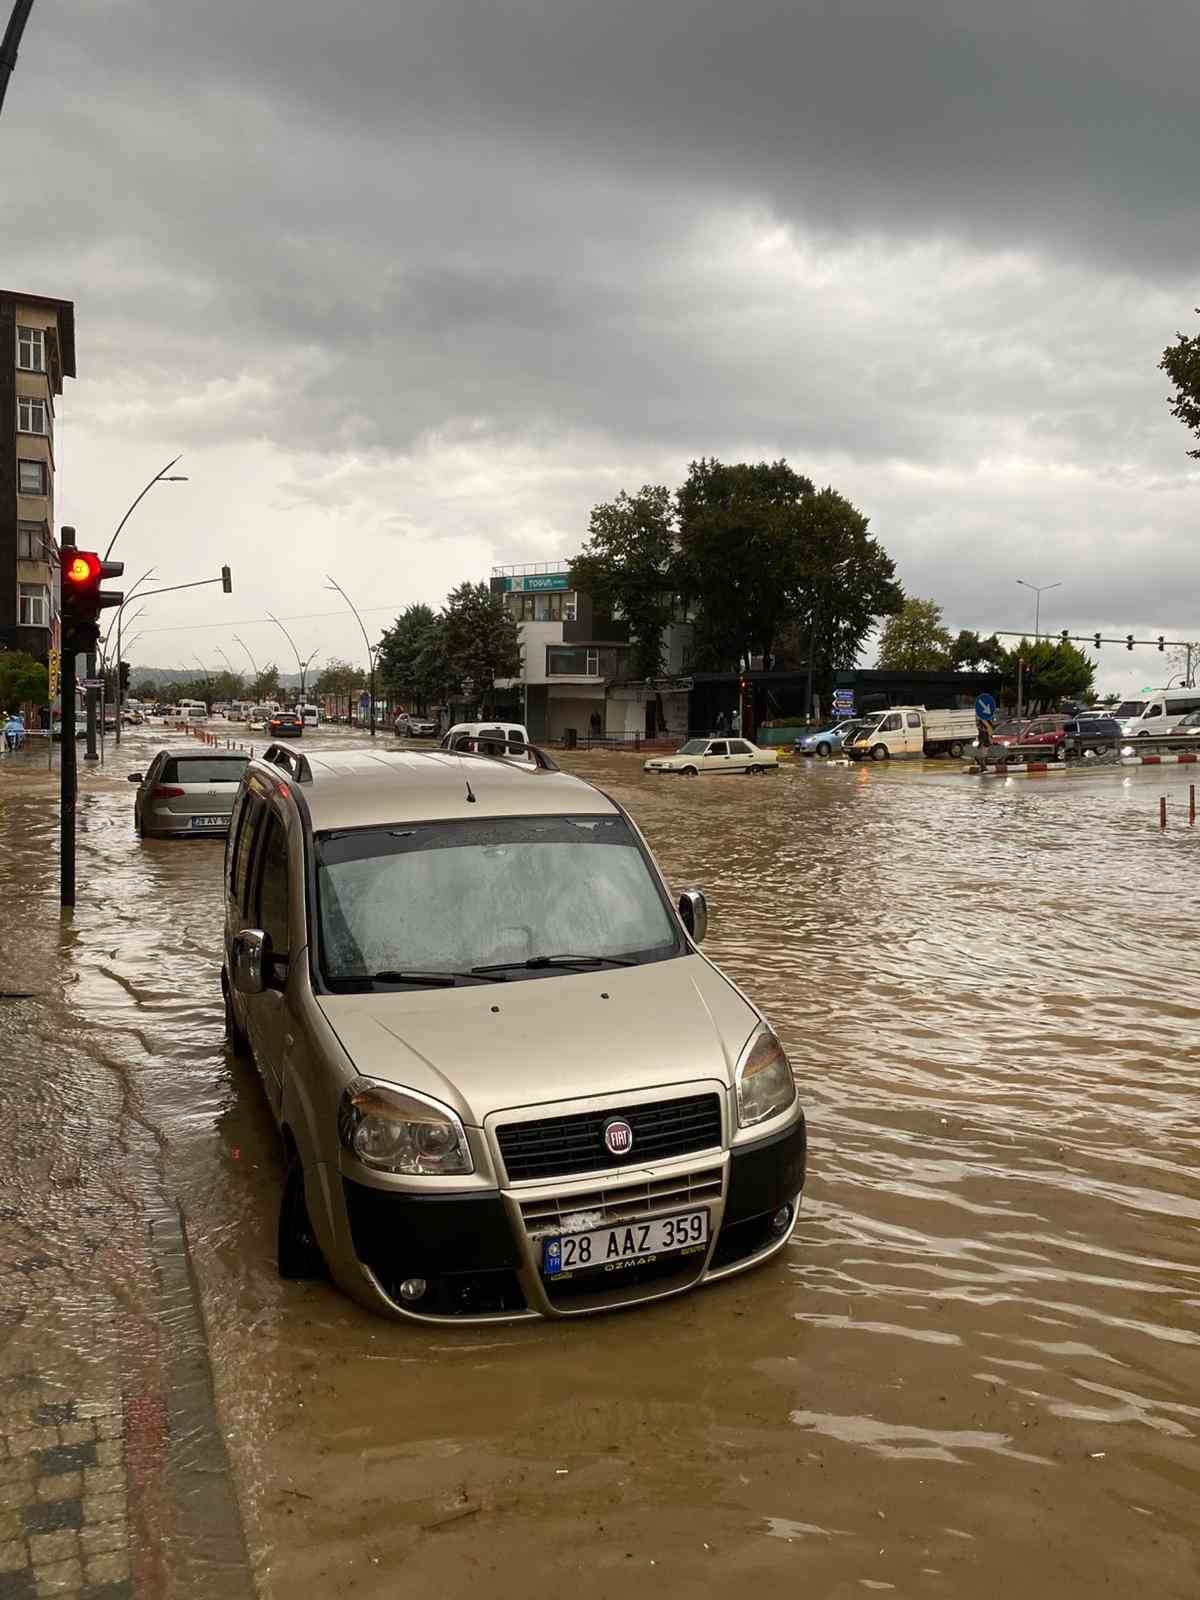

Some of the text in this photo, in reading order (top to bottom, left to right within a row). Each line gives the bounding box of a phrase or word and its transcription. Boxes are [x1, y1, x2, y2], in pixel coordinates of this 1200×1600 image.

[610, 1130, 627, 1147] FIAT
[563, 1215, 702, 1267] 28 AAZ 359
[549, 1257, 560, 1266] TR
